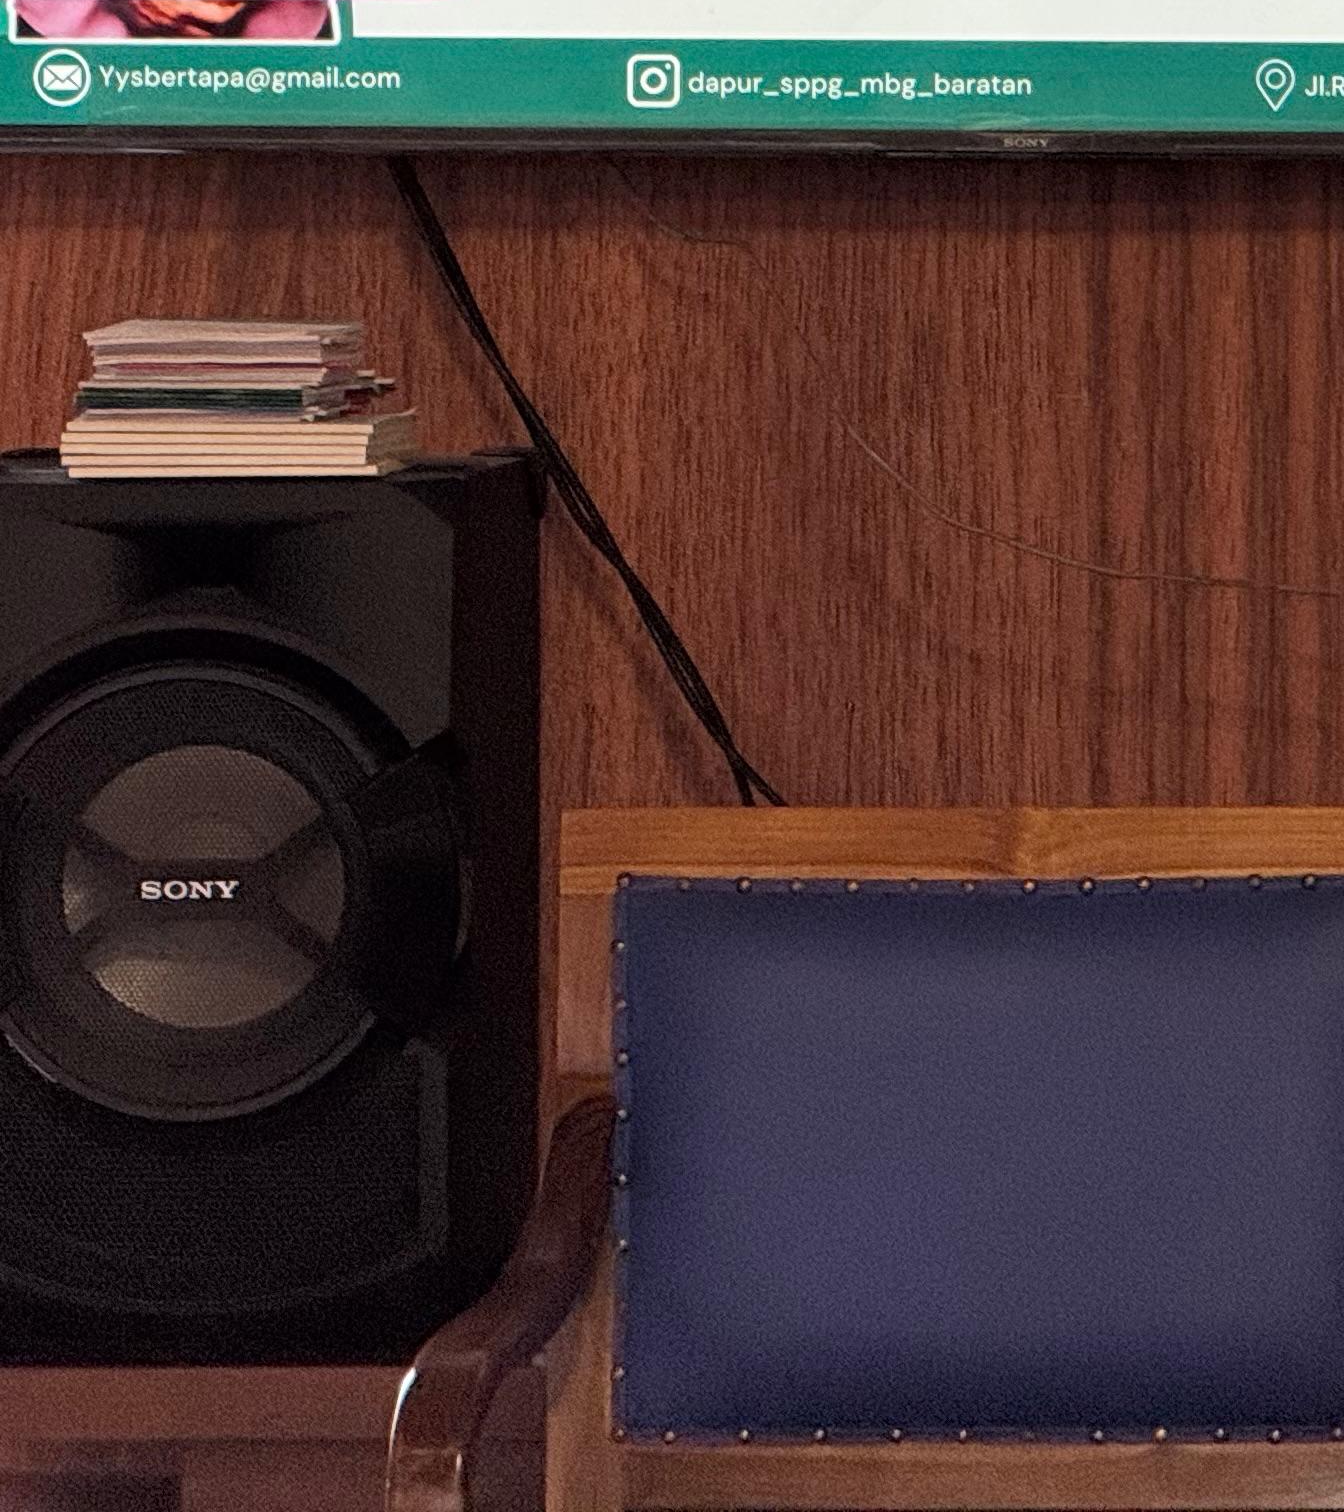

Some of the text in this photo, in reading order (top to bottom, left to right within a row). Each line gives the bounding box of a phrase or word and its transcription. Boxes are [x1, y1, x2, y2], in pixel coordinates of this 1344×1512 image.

[98, 64, 401, 94] Yysbertapa@gmail.com
[687, 70, 1032, 101] dapur_sppg_mbg_baratan
[1003, 137, 1049, 148] SONY
[140, 880, 240, 900] SONY
